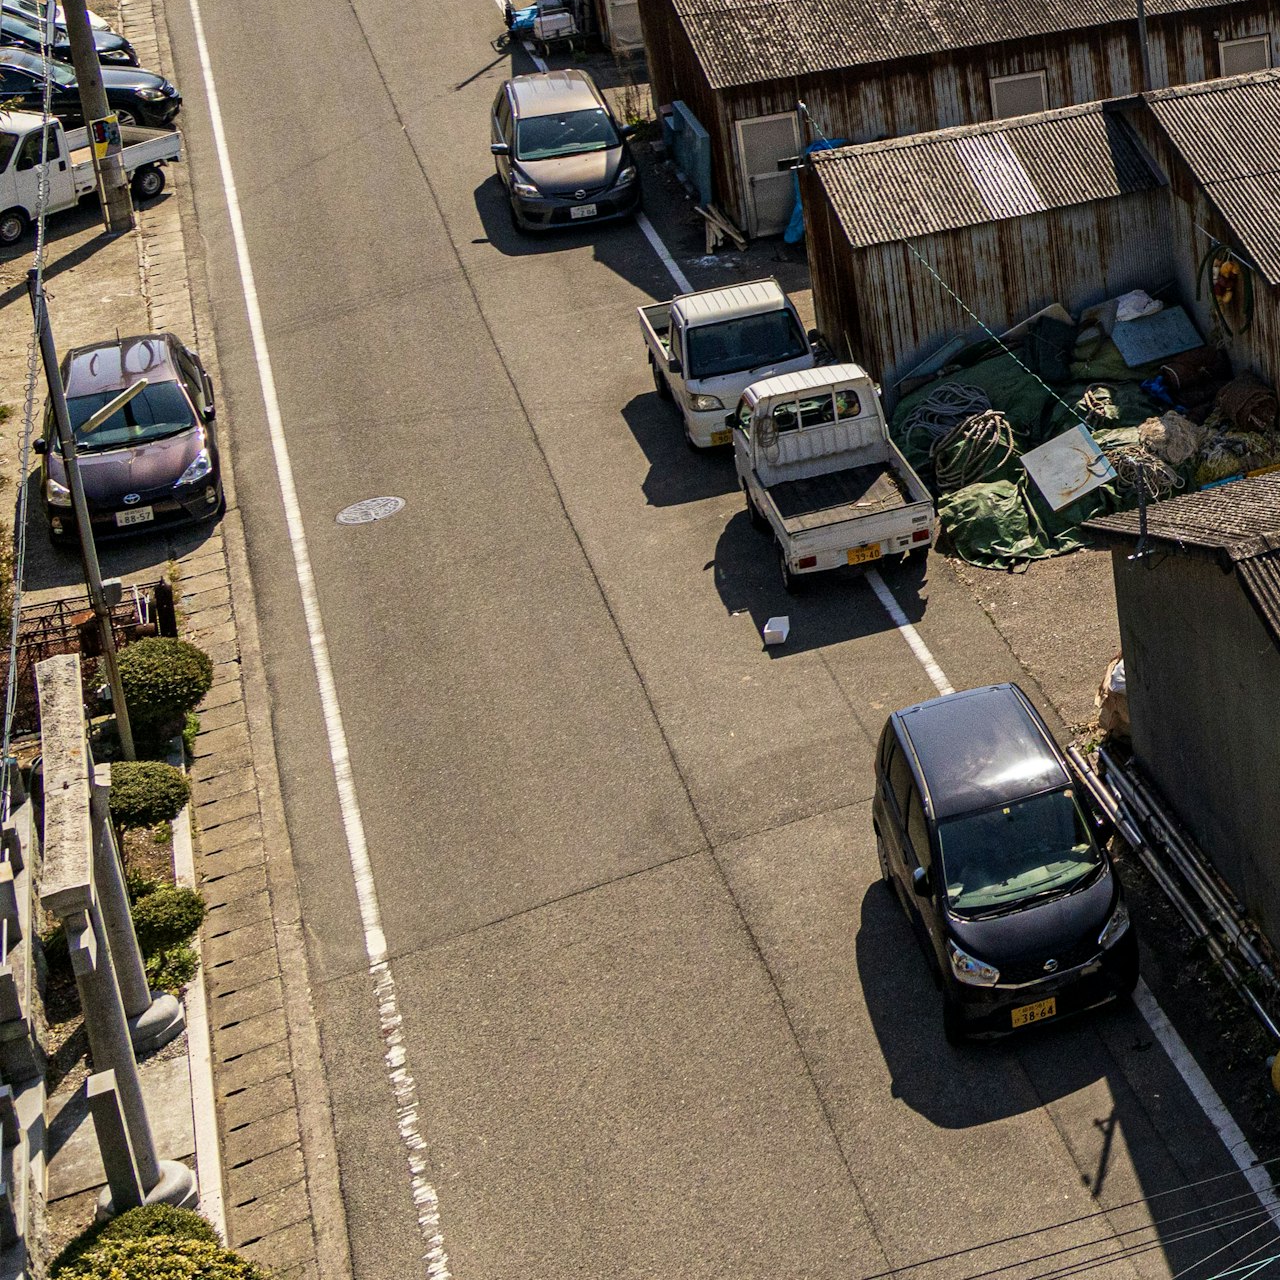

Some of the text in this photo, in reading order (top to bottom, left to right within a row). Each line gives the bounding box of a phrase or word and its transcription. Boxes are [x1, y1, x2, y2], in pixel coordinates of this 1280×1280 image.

[124, 512, 151, 523] 88-57
[855, 550, 880, 562] 39-40
[1022, 1005, 1053, 1023] 38-64
